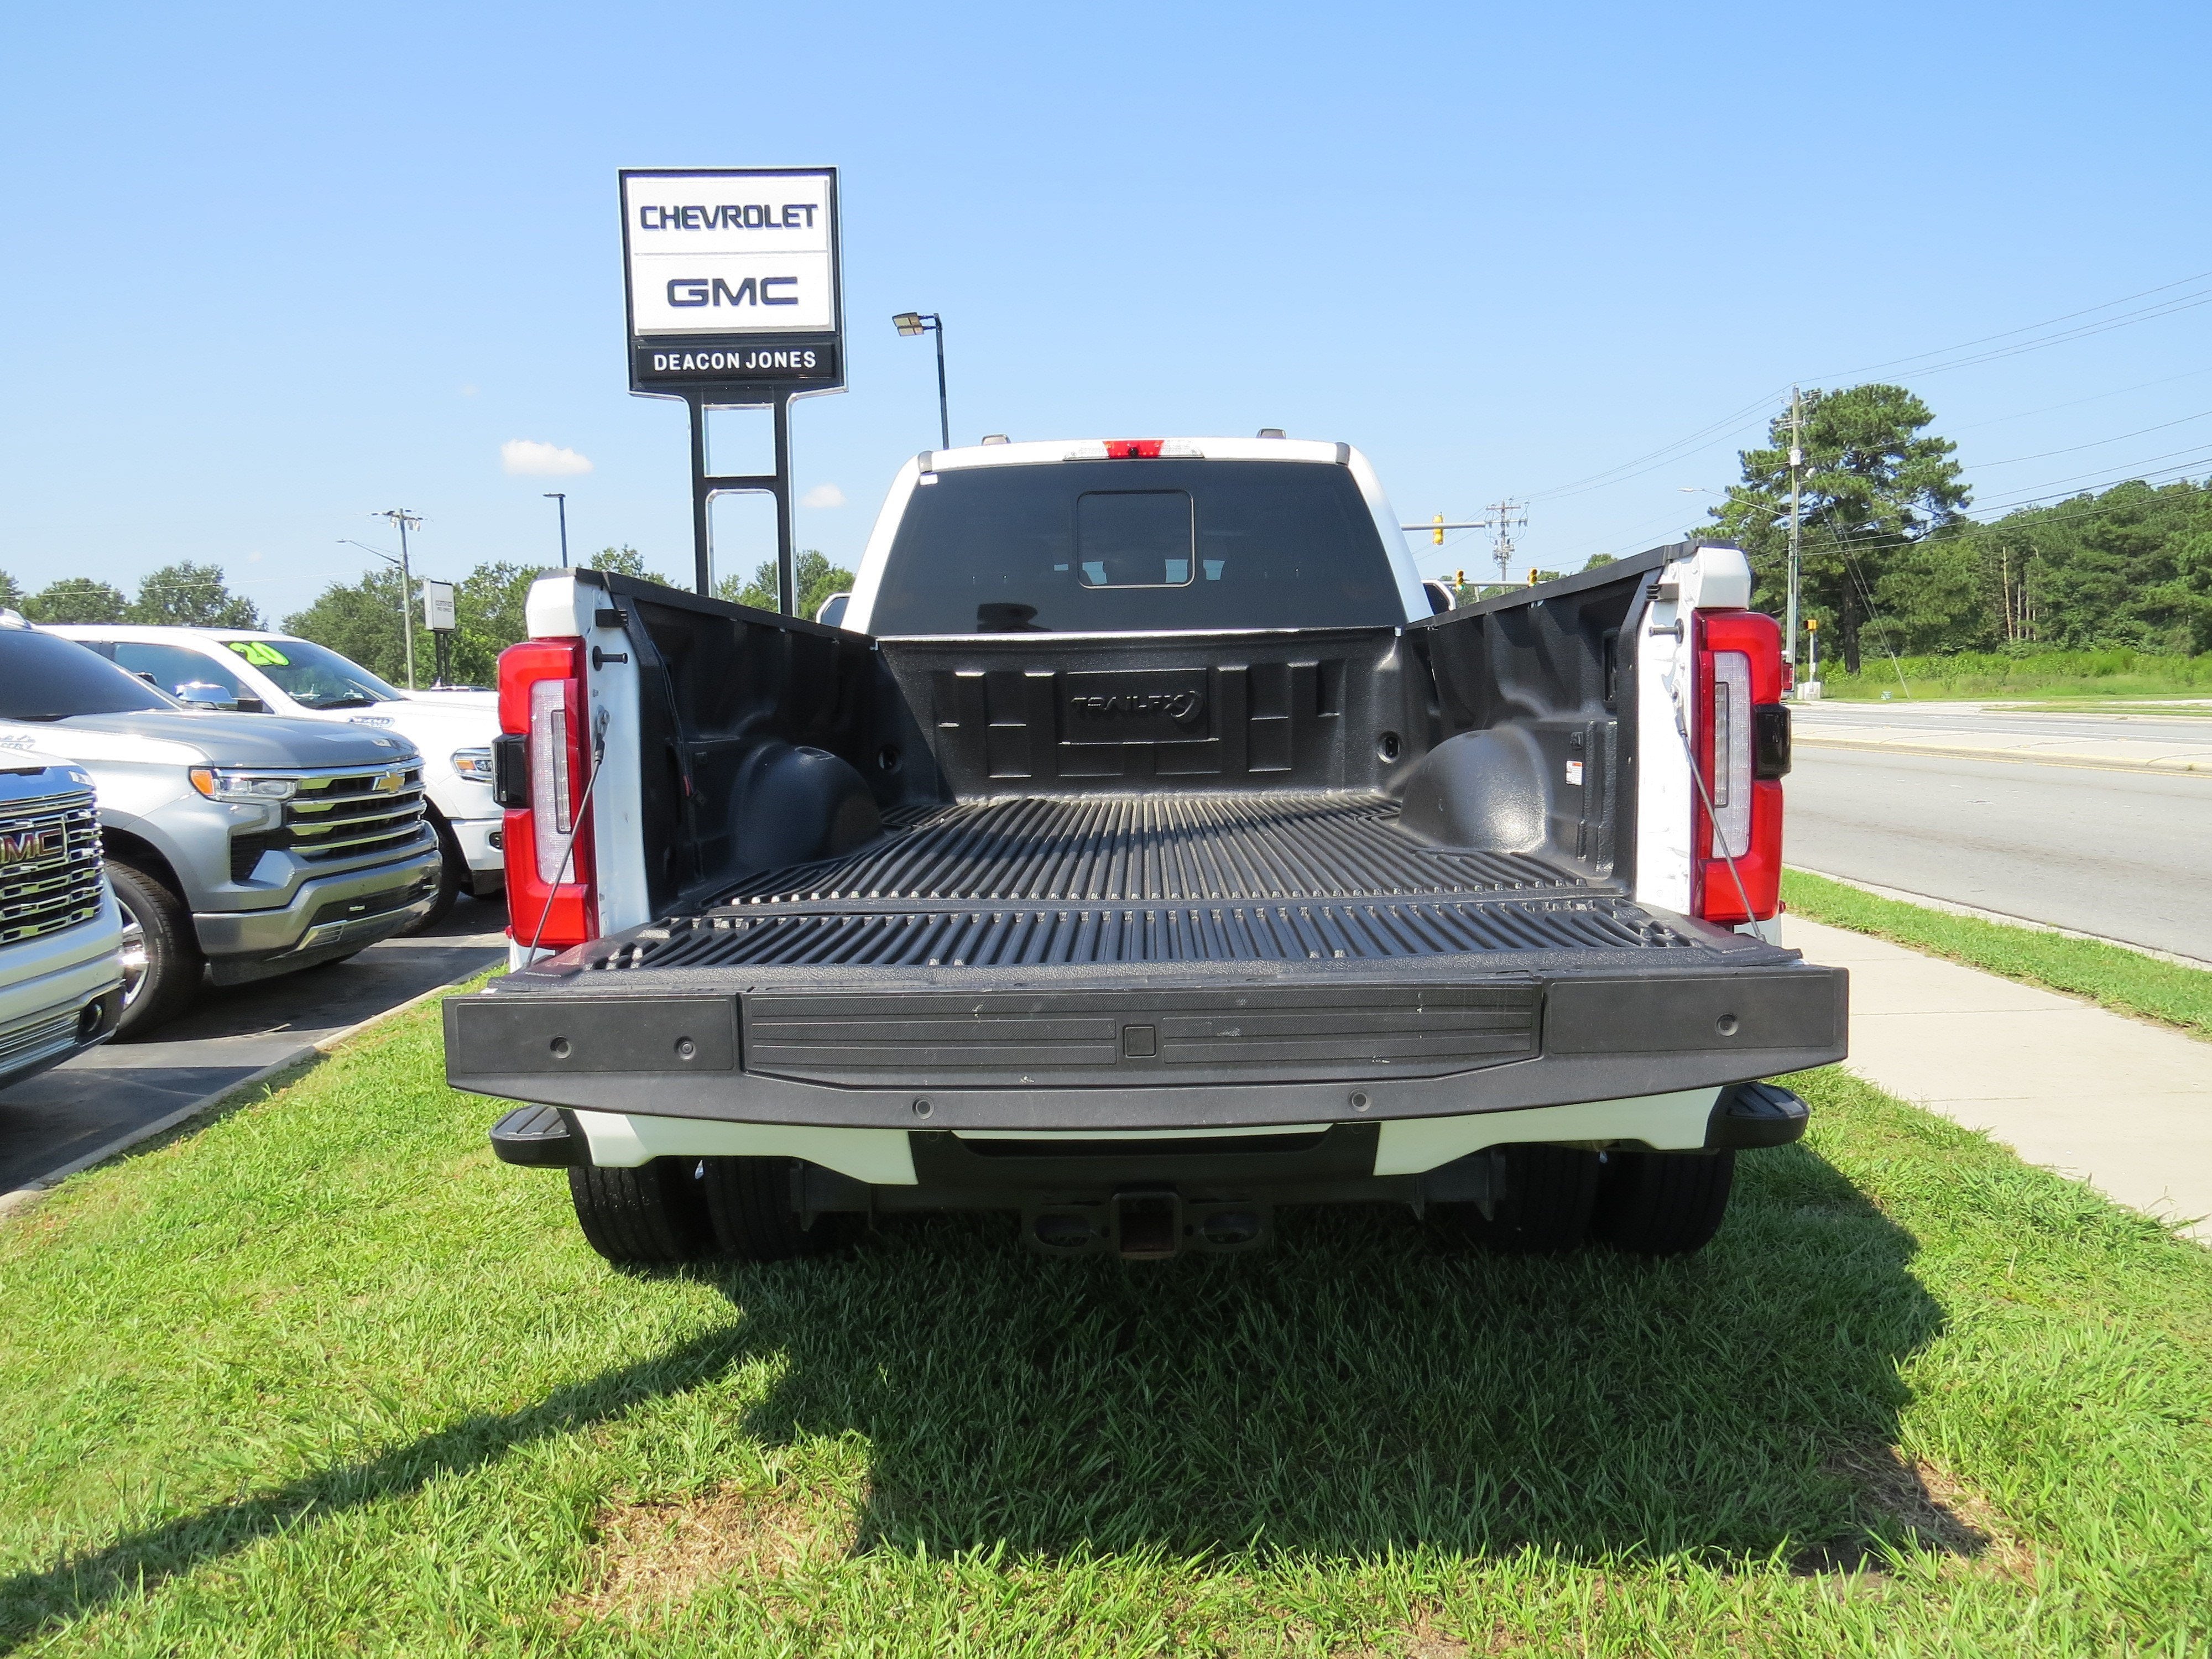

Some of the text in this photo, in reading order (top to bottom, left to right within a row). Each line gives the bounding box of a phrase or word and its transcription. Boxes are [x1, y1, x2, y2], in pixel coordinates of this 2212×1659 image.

[640, 204, 818, 229] CHEVROLET
[667, 276, 799, 307] GMC
[654, 351, 817, 371] DEACON JONES
[228, 641, 290, 666] 20
[0, 828, 62, 863] MC
